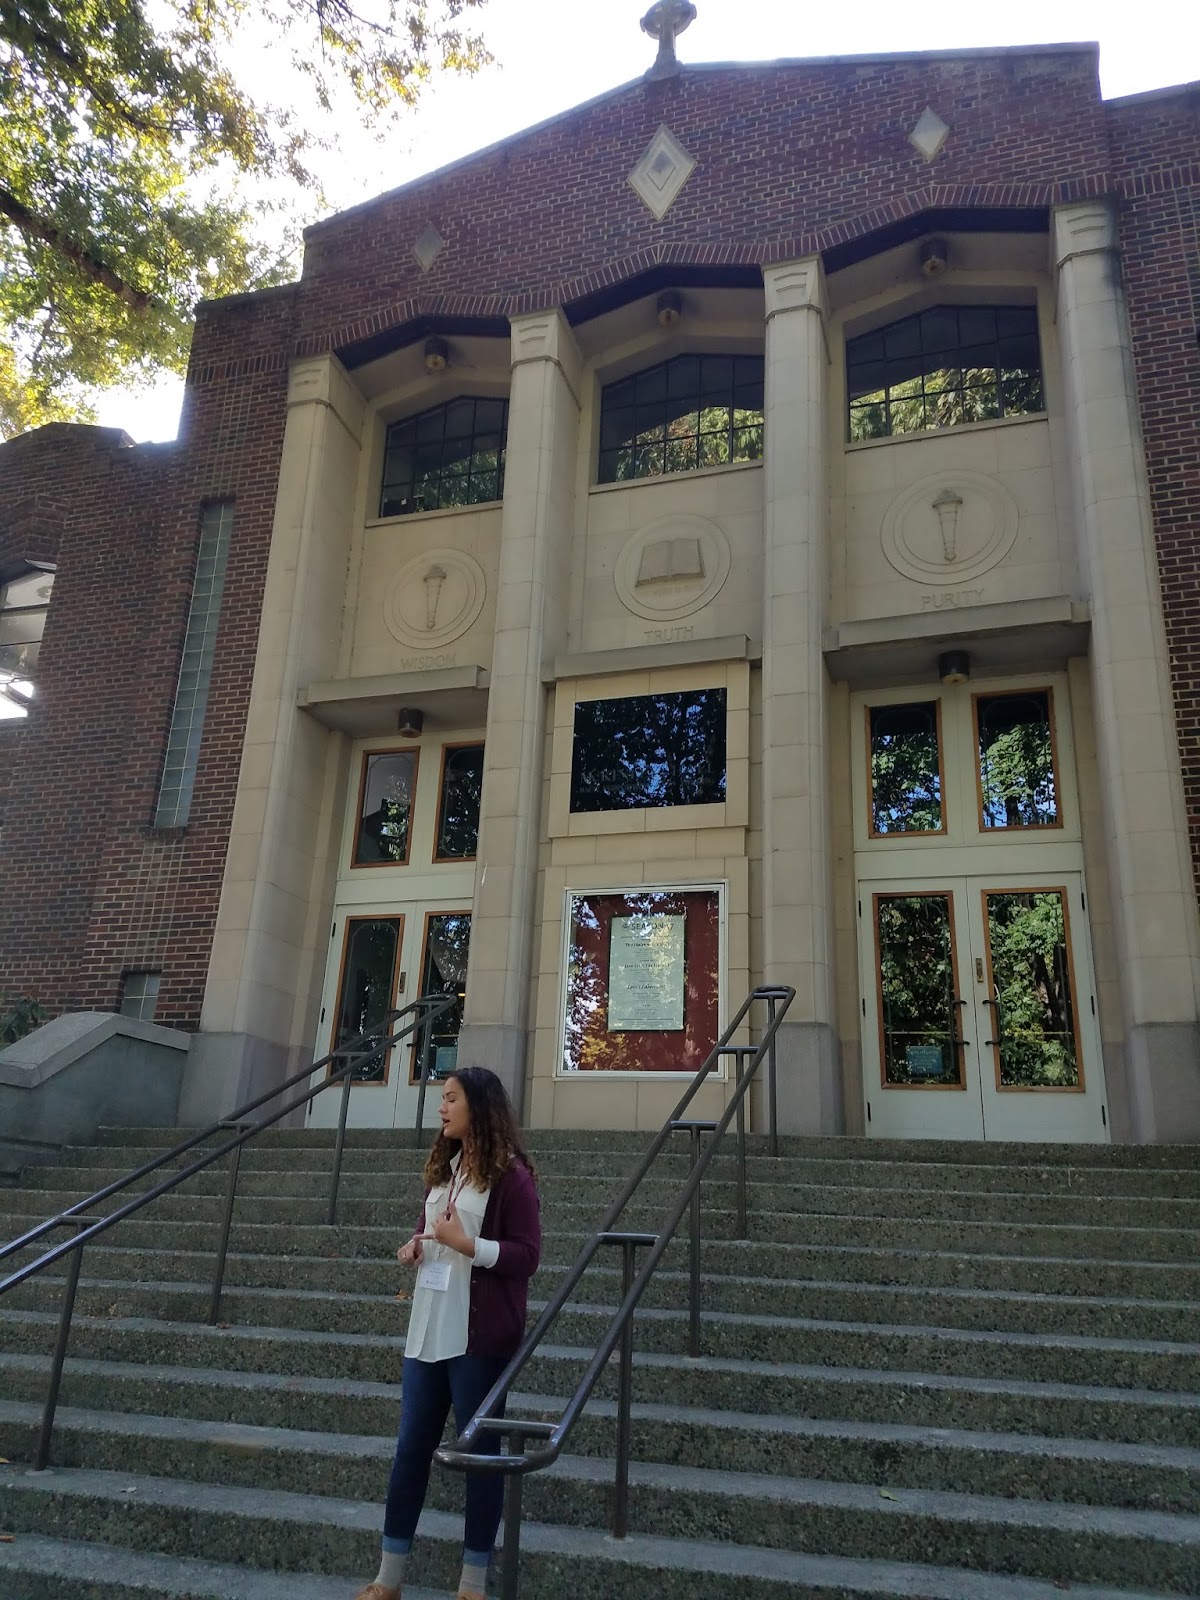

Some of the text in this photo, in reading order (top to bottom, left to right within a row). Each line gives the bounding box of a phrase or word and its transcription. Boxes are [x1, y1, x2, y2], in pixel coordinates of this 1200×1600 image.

[921, 588, 984, 610] PURITY
[644, 625, 694, 644] TRUTH
[400, 653, 457, 670] WISDOM
[580, 764, 661, 783] MCKIN
